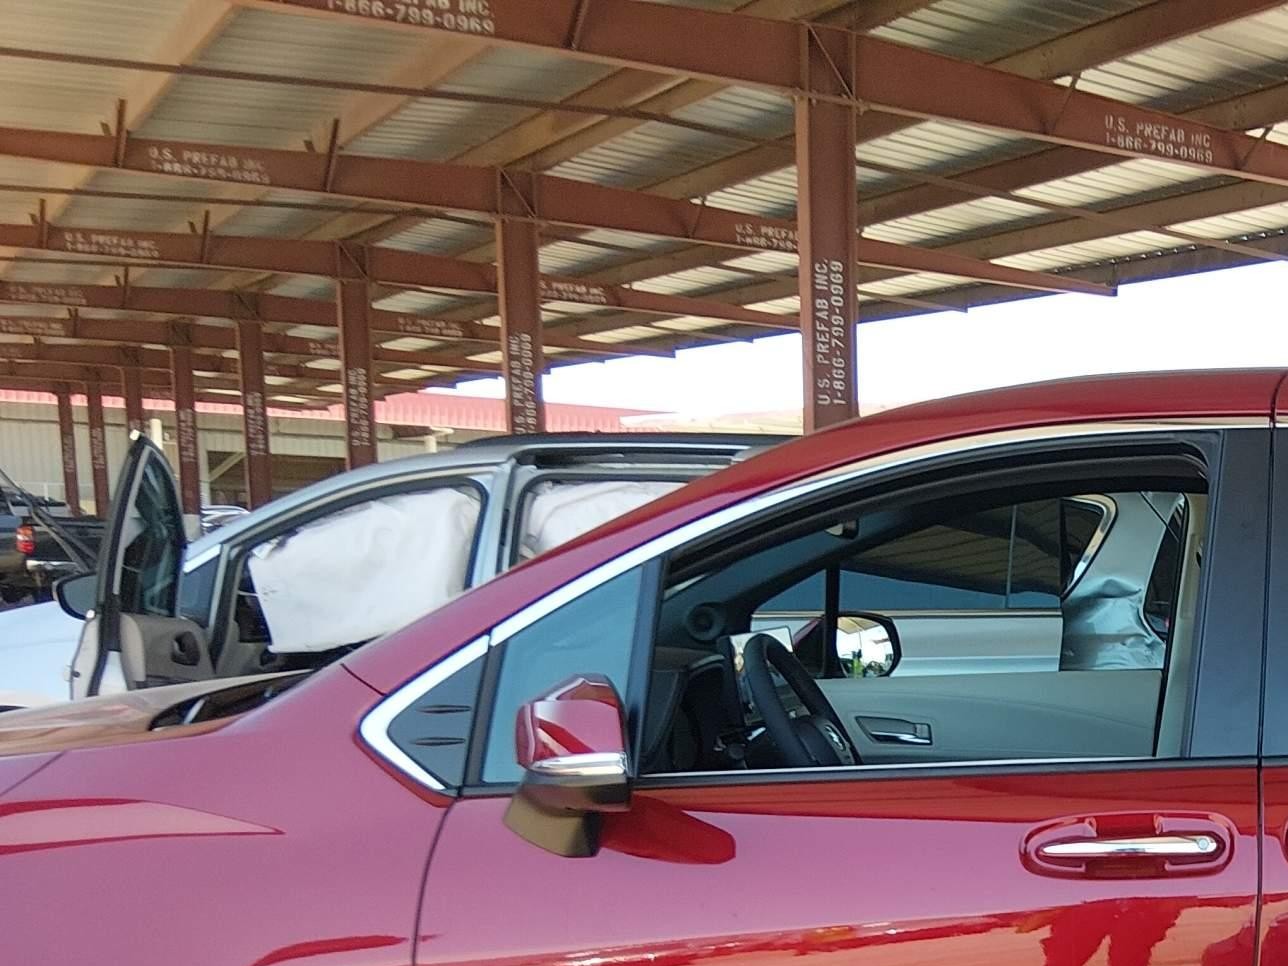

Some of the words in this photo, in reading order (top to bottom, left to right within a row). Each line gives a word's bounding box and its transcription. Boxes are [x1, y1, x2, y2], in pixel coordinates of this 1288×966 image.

[1105, 114, 1130, 134] U.S.
[1136, 122, 1185, 144] PREFAB
[1105, 131, 1213, 163] 1-866-799-0969
[814, 258, 829, 290] INC.
[815, 298, 830, 364] PREFAB
[830, 260, 847, 405] 1-866-799-0969
[816, 371, 831, 405] U.S.
